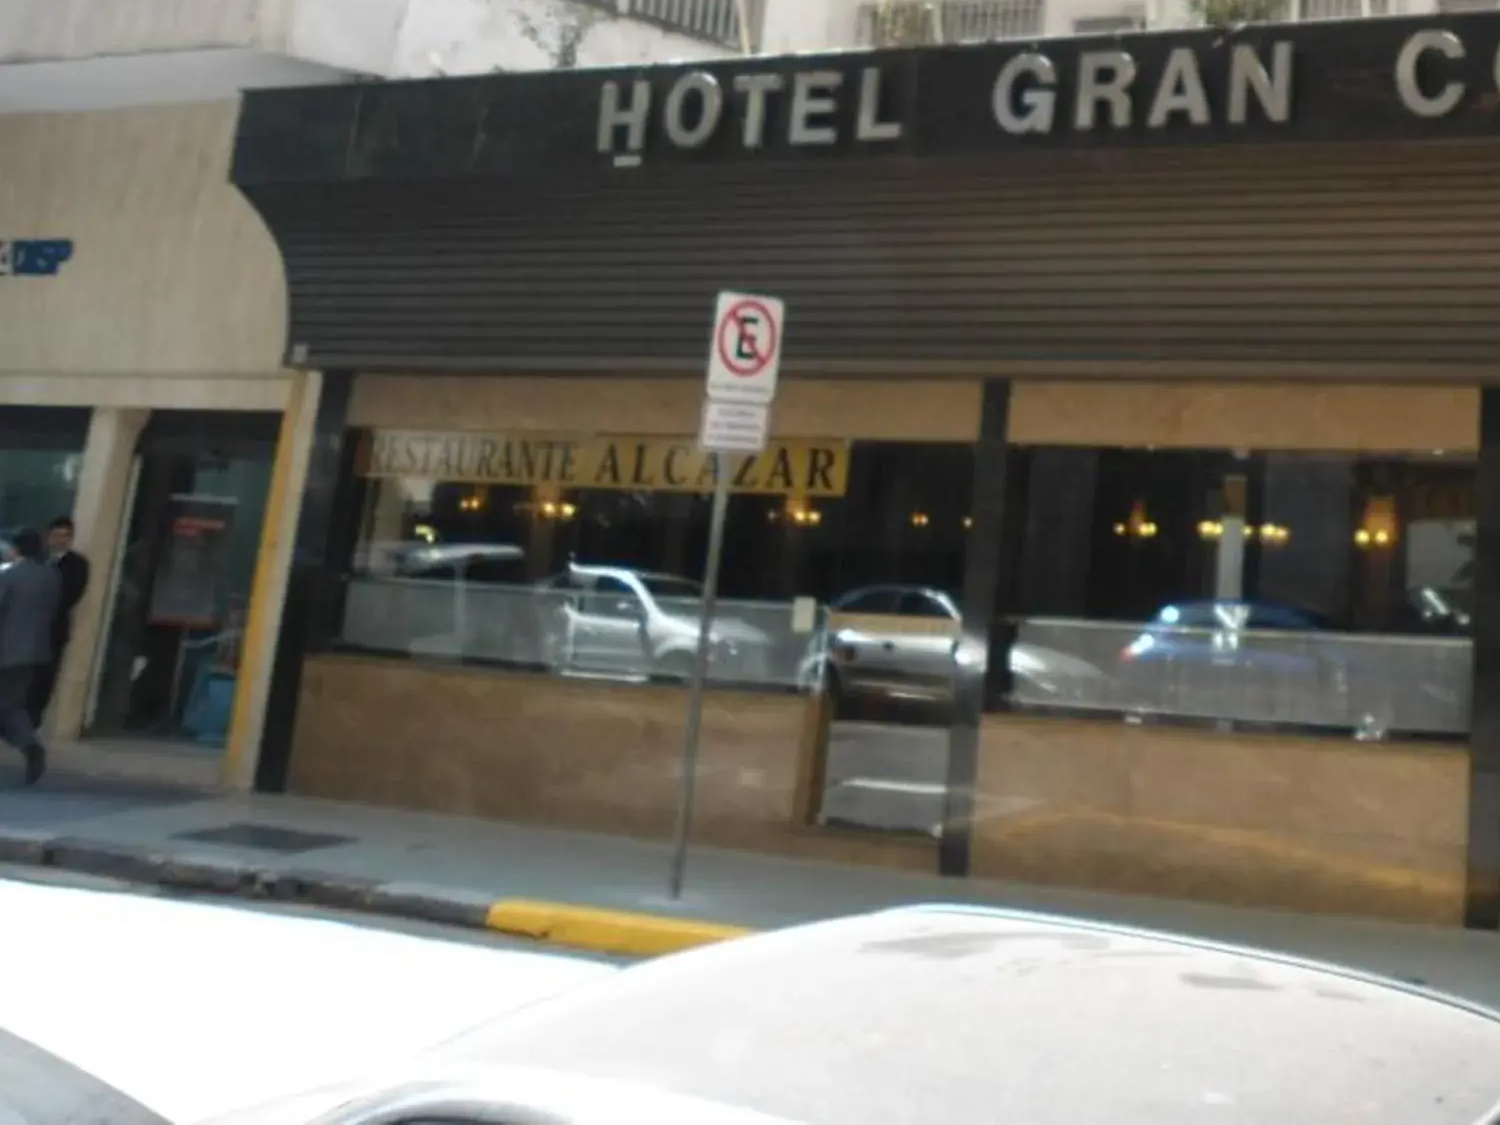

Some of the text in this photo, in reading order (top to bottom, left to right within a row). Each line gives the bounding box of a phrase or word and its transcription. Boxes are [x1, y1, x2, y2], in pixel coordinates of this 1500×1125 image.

[598, 67, 904, 153] HOTEL
[991, 40, 1294, 137] GRAN
[735, 316, 760, 361] E
[371, 433, 837, 492] RESTAURANTE ALCAZAR
